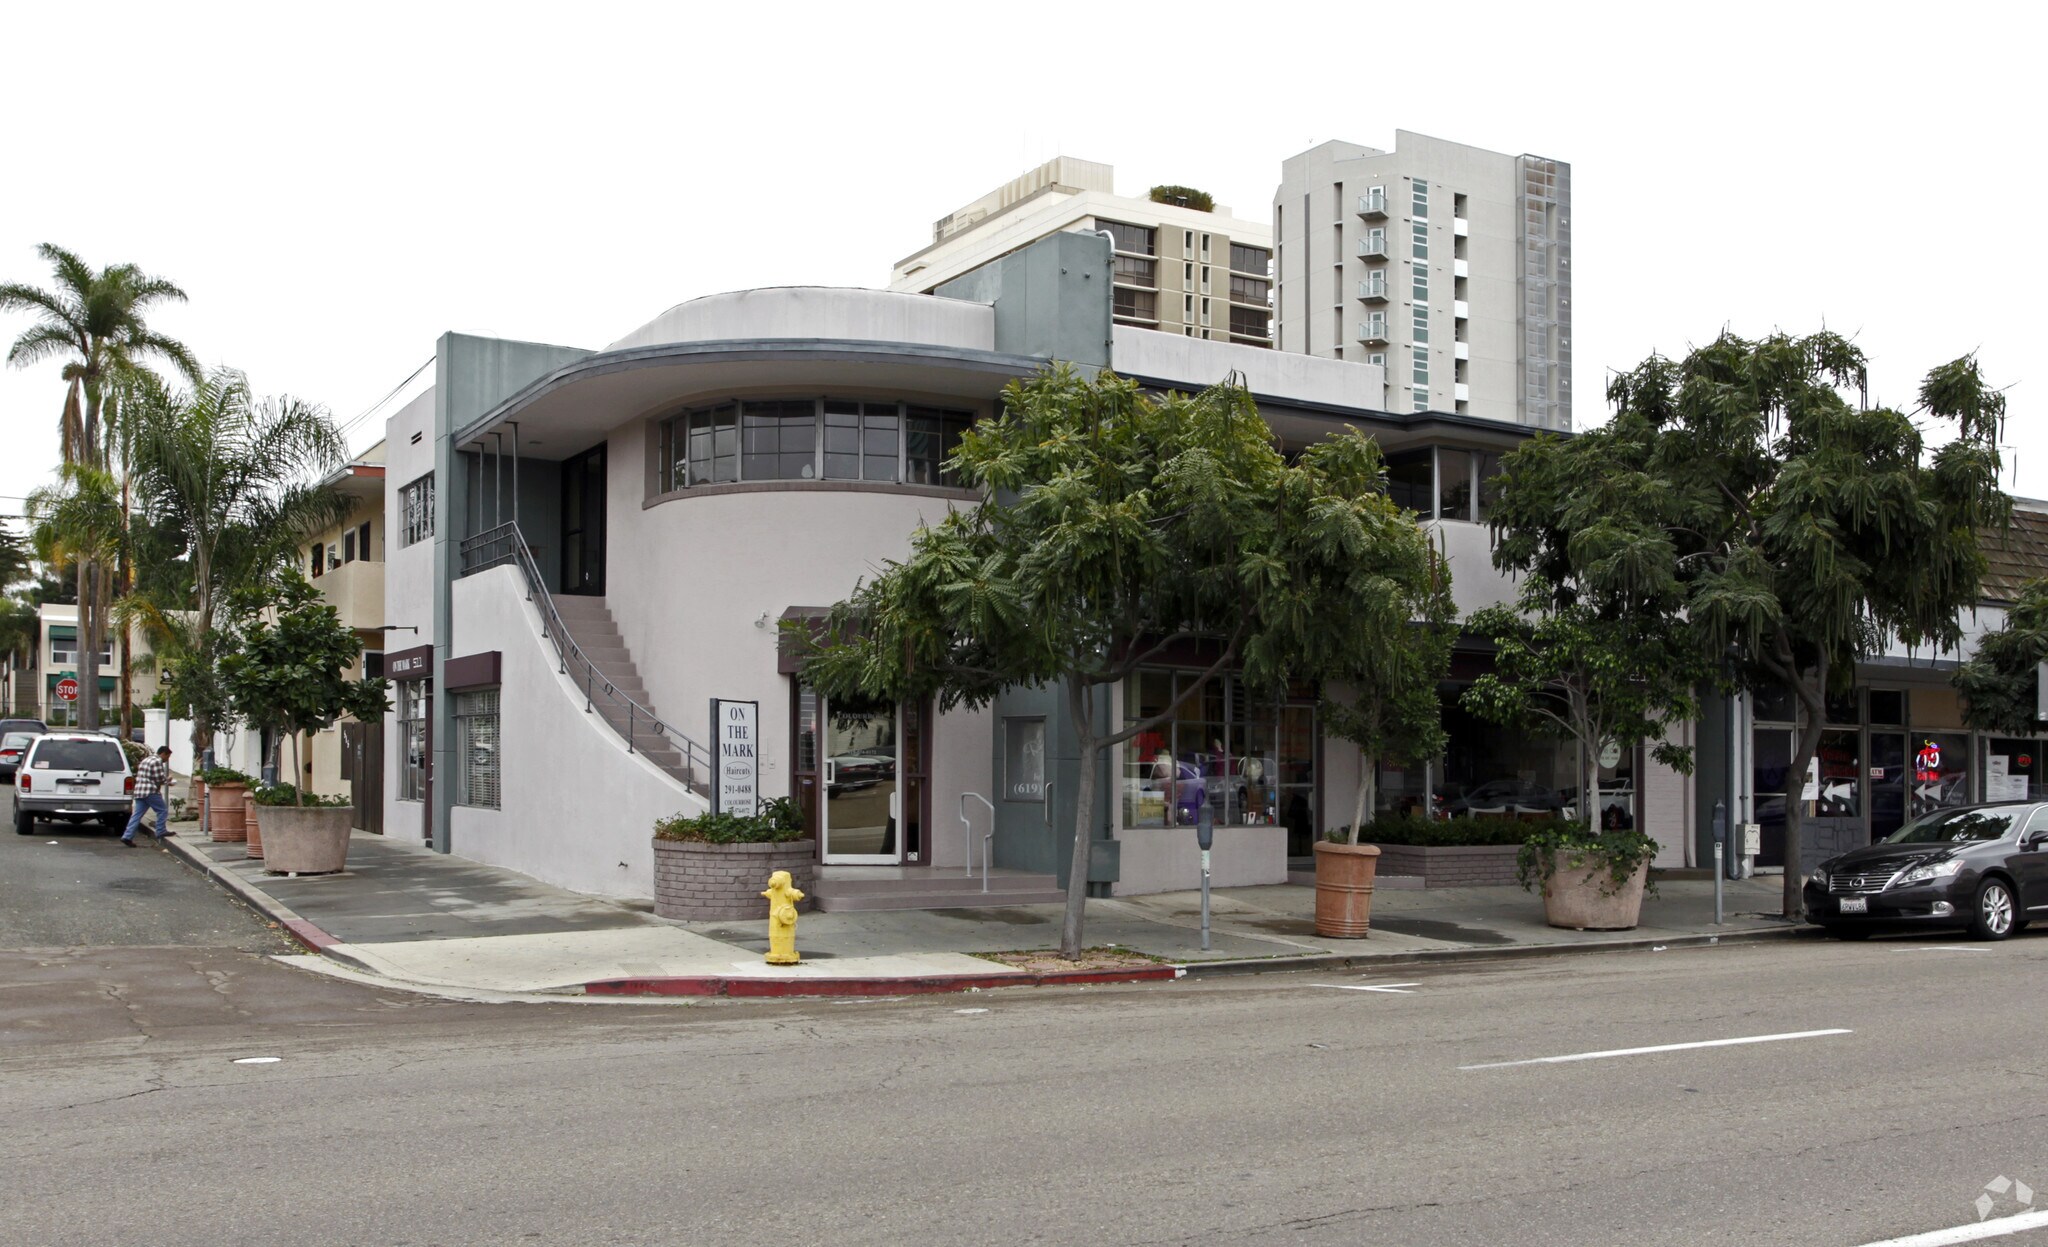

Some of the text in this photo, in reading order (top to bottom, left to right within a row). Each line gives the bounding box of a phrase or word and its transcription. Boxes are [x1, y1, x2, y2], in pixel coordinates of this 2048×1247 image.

[730, 707, 745, 721] ON
[728, 725, 748, 739] THE
[723, 743, 754, 757] MARK
[726, 766, 751, 776] Haircuts
[725, 785, 752, 794] 291-0488
[1013, 783, 1042, 795] (619)
